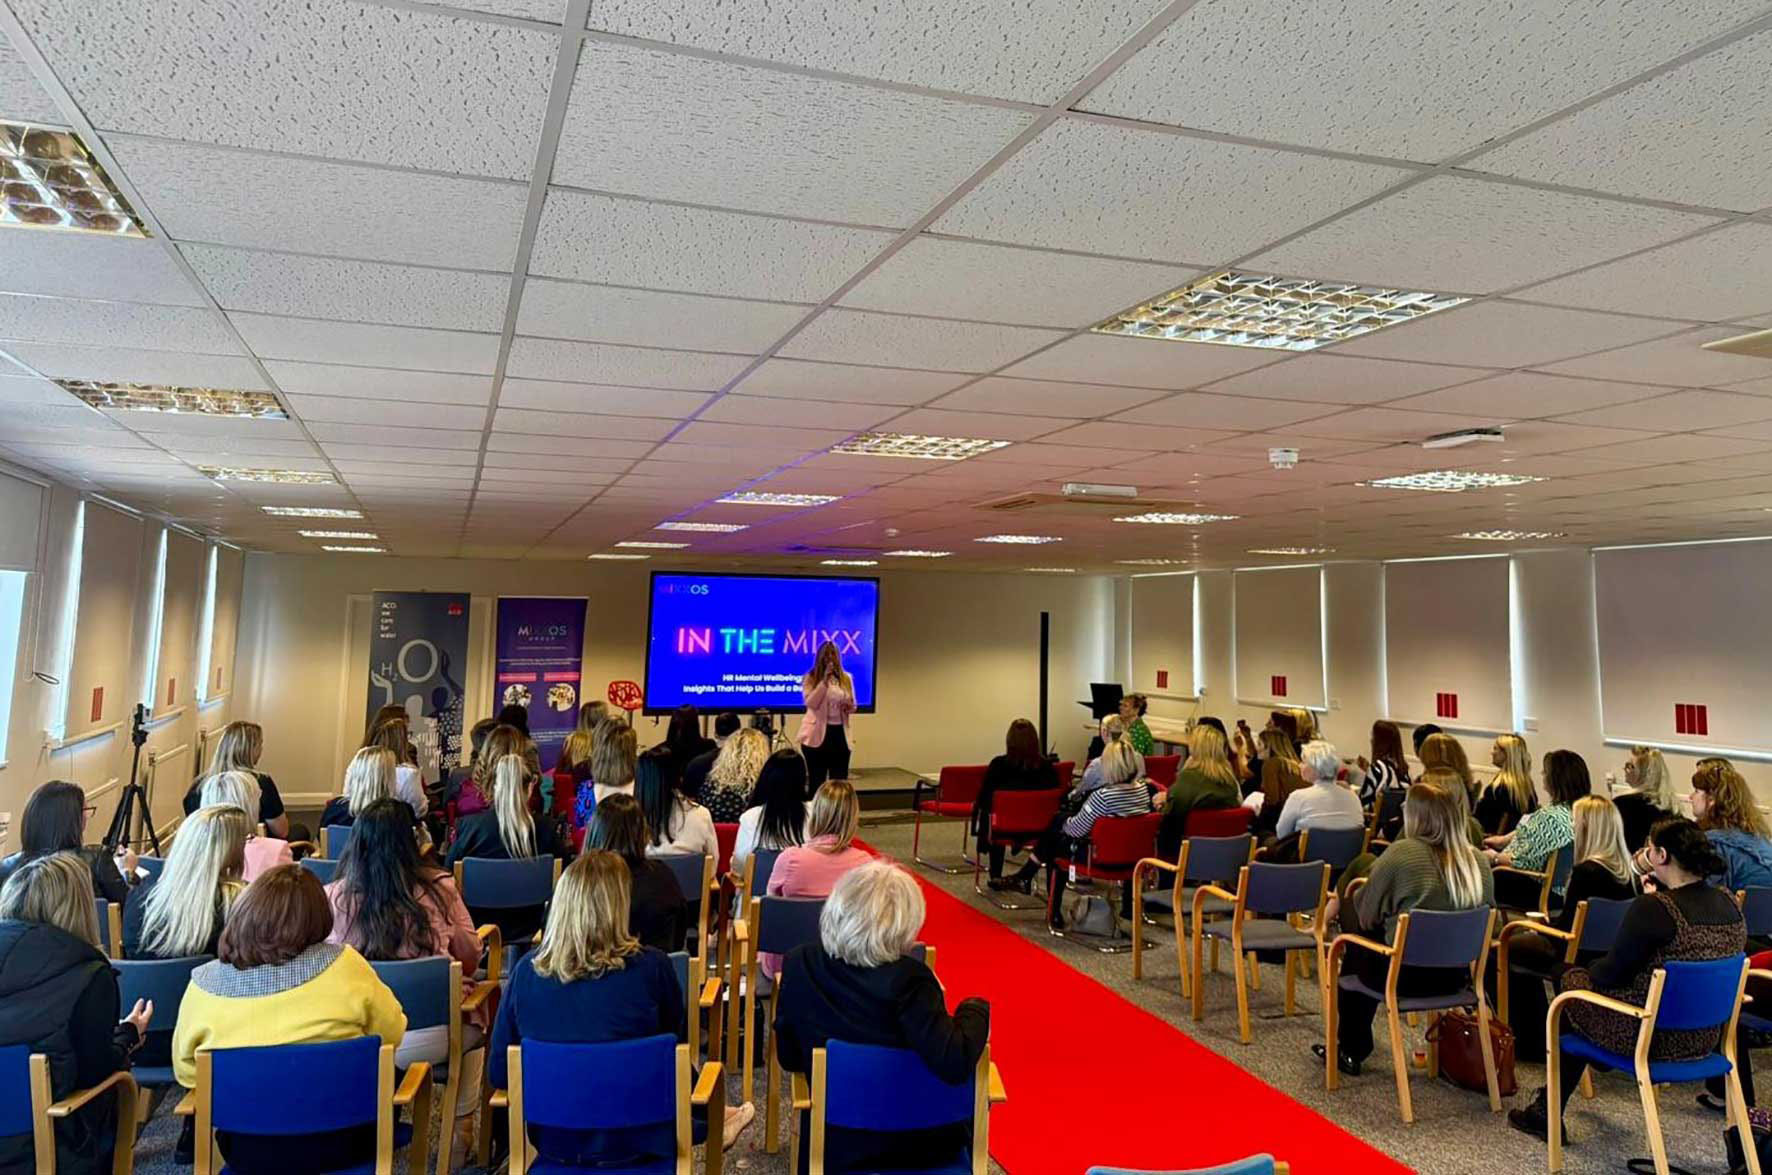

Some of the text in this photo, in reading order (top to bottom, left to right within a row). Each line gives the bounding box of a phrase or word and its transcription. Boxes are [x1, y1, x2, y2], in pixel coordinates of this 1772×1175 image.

[517, 625, 568, 636] MIOS
[677, 628, 862, 655] IN THE MIXX
[722, 673, 735, 682] HR
[734, 673, 762, 682] Mental
[682, 684, 716, 695] Insights
[716, 684, 735, 693] That
[735, 684, 754, 695] Help
[754, 685, 765, 693] Us
[765, 684, 786, 693] Build
